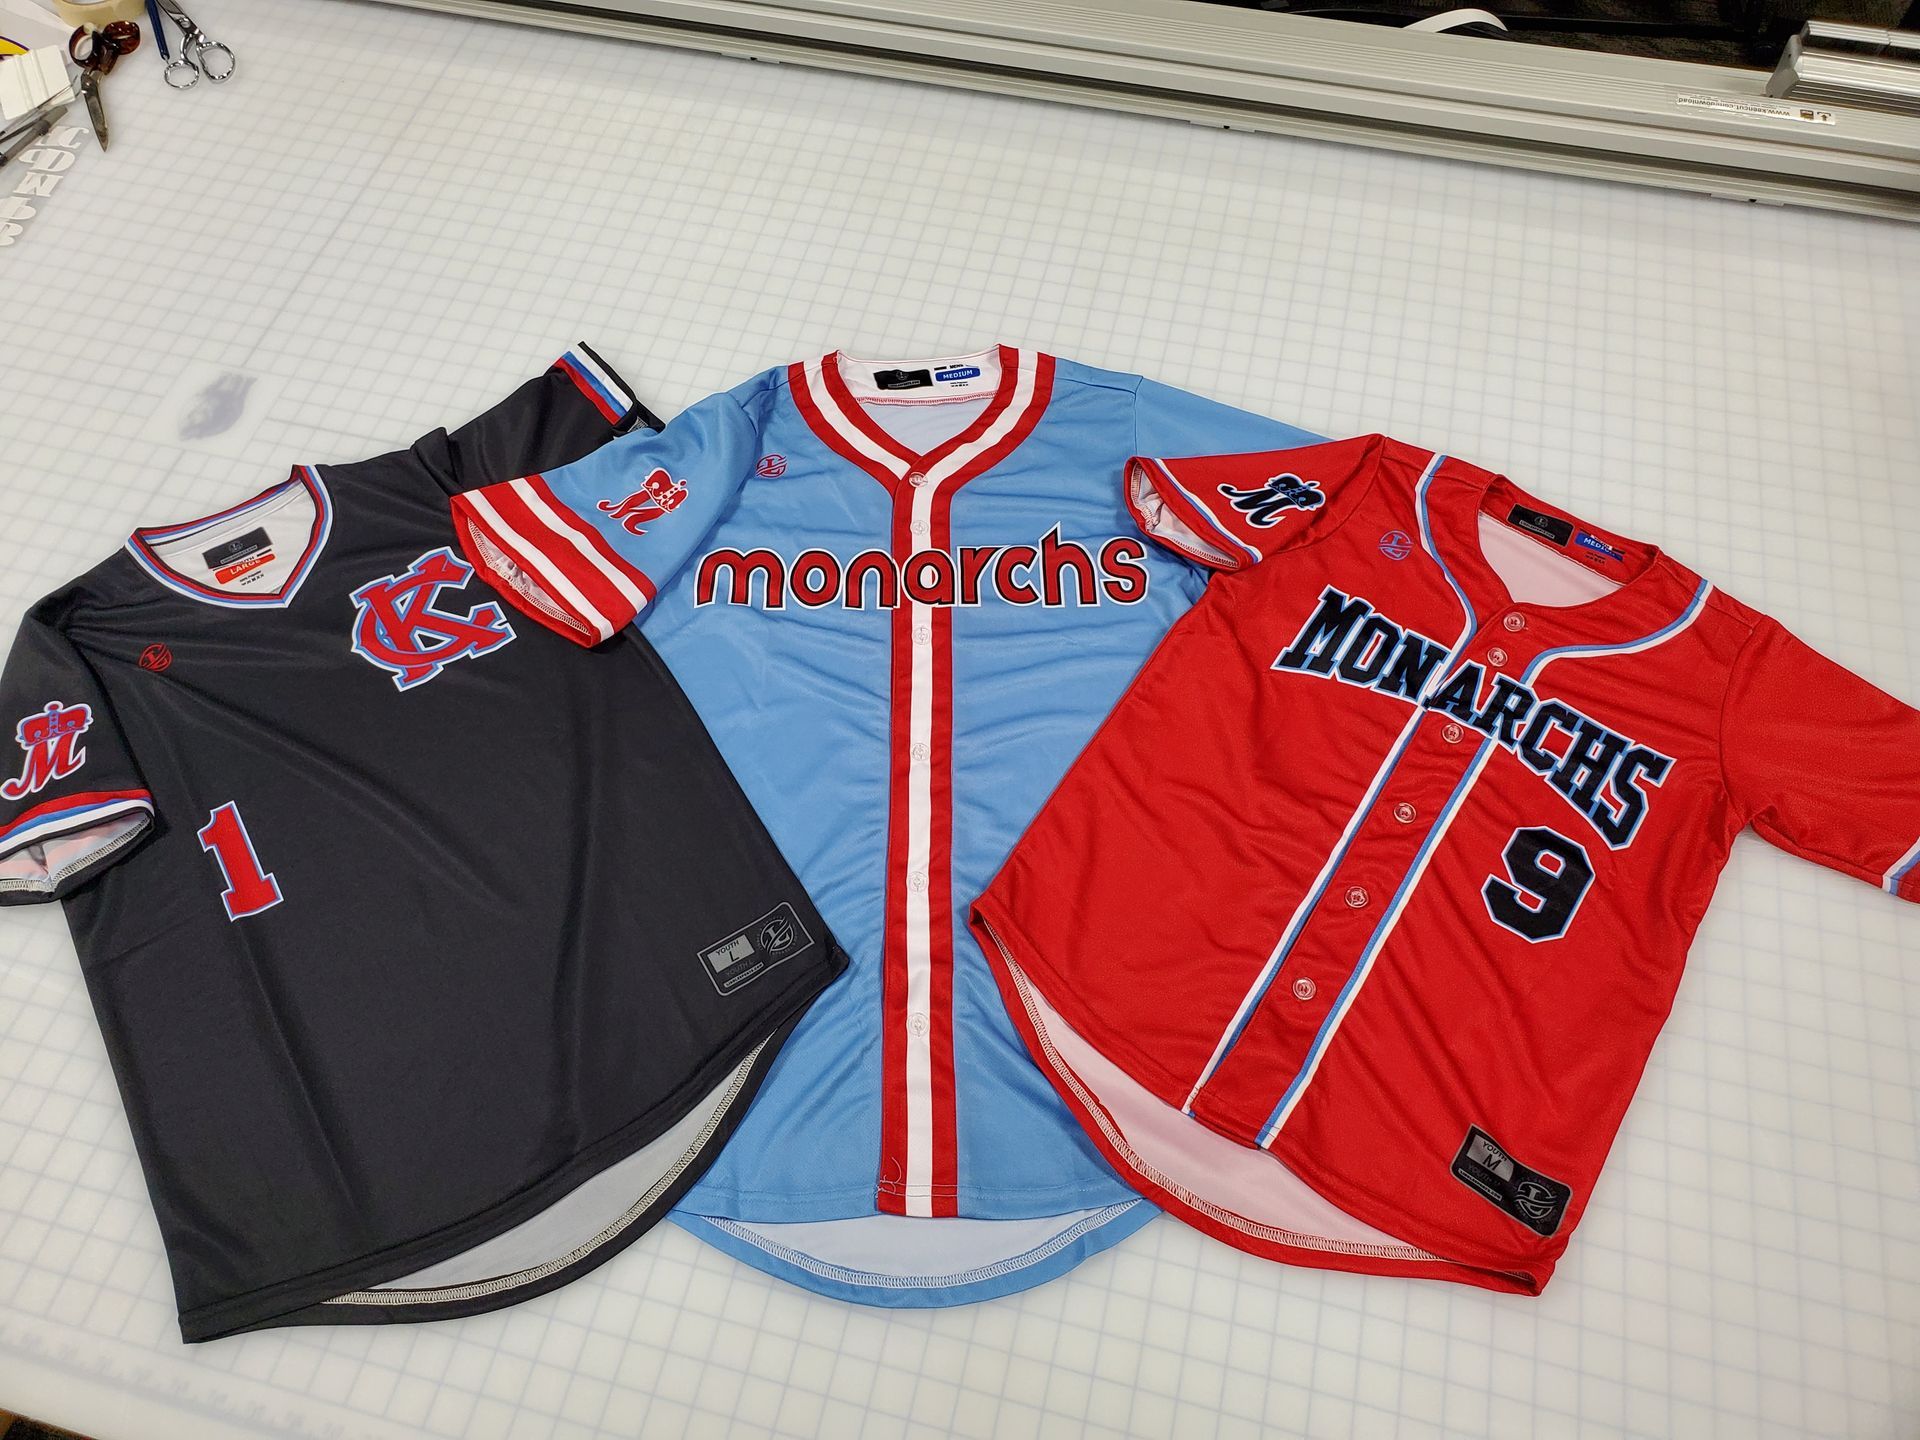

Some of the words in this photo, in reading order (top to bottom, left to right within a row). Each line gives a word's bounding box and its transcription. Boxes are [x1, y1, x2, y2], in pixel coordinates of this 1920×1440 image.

[943, 369, 973, 379] MEDIUM
[694, 521, 1150, 611] monarchs
[1271, 584, 1676, 850] MONARCHS
[197, 800, 284, 922] 1
[1482, 826, 1596, 944] 9
[715, 940, 740, 956] YOUTH
[729, 951, 740, 962] L
[1483, 1154, 1502, 1171] M
